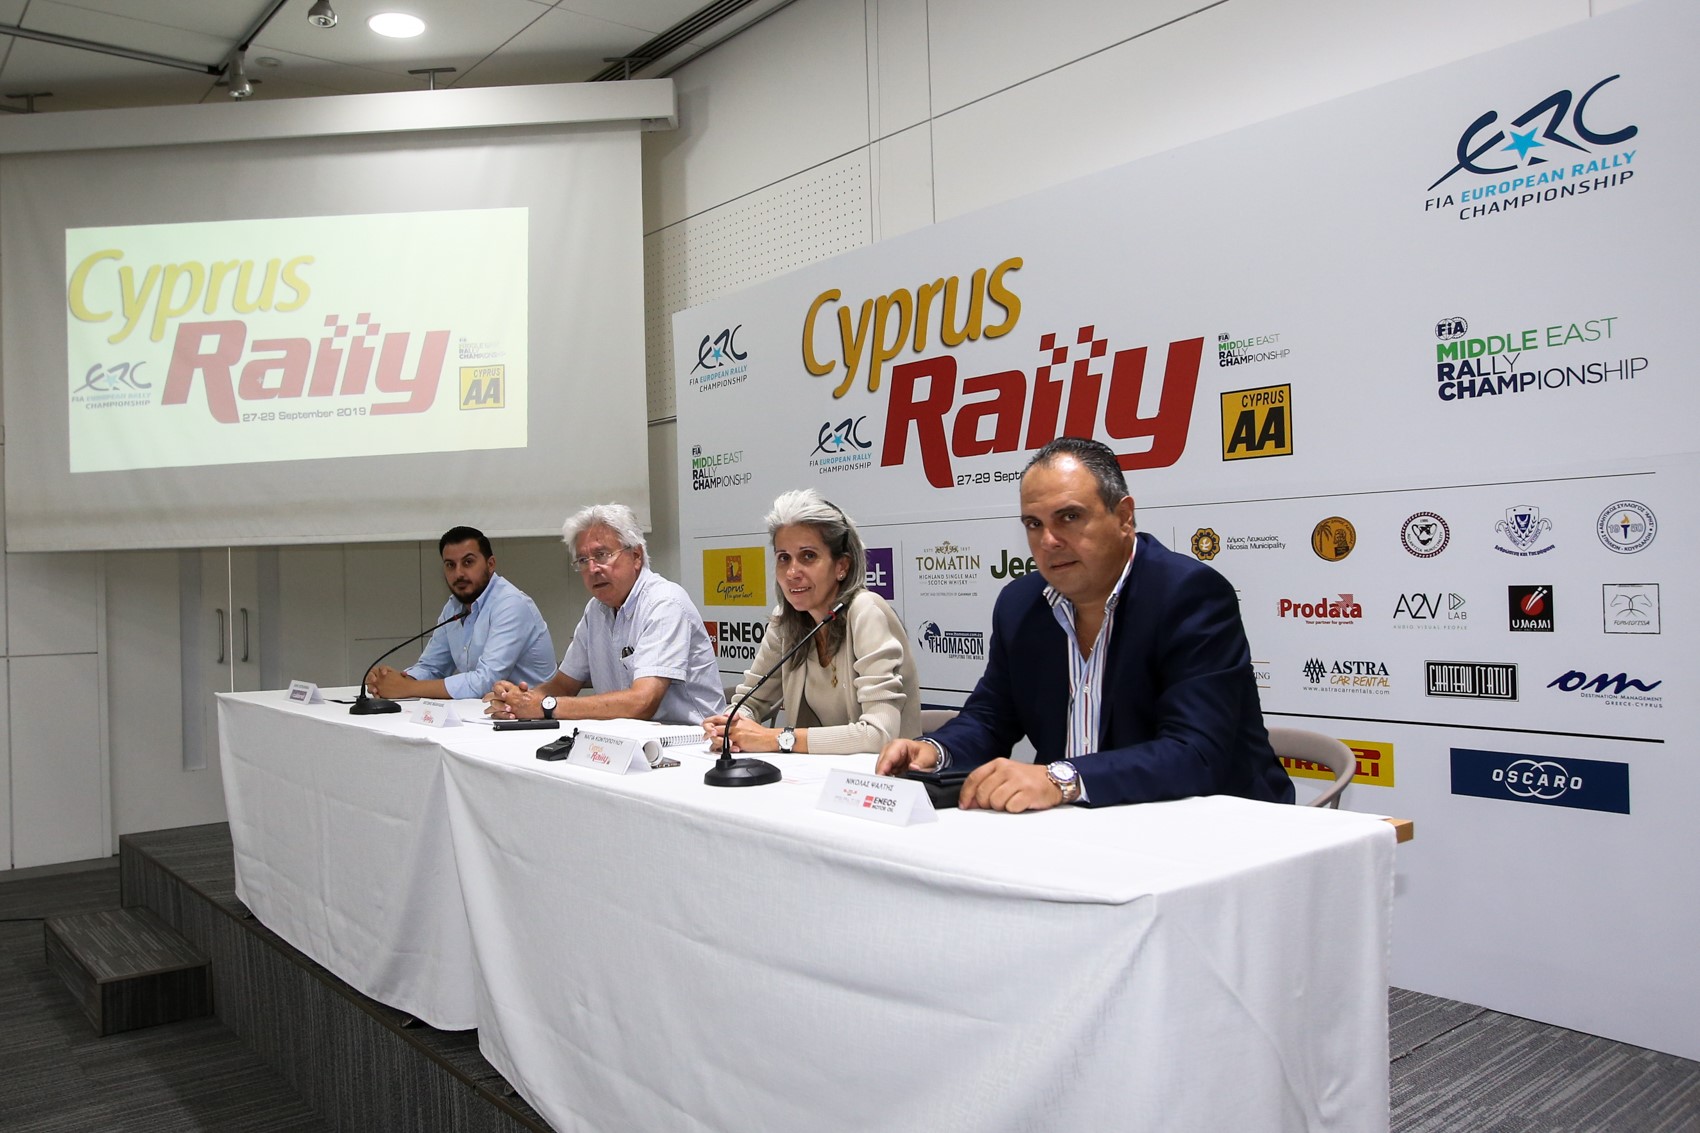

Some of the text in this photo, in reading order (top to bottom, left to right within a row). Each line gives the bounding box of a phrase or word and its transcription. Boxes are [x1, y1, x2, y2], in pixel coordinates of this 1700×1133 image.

[1425, 150, 1637, 211] FIA EUROPEAN RALLY
[1459, 170, 1634, 220] CHAMPIONSHIP
[68, 249, 315, 344] Cyprus
[803, 257, 1023, 398] Cyprus
[1218, 333, 1280, 351] MIDDLE EAST
[1436, 317, 1618, 362] MIDDLE EAST
[1219, 347, 1248, 359] RALLY
[1219, 349, 1290, 367] CHAMPIONSHIP
[161, 312, 451, 424] Rally
[473, 368, 501, 378] CYPRUS
[689, 364, 748, 386] FIA EUROPEAN RALLY
[1437, 352, 1520, 382] RALLY
[699, 375, 748, 392] CHAMPIONSHIP
[1438, 357, 1648, 401] CHAMPIONSHIP
[463, 378, 500, 405] AA
[1241, 390, 1284, 408] CYPRUS
[86, 400, 151, 410] CHAMPIONSHIP
[880, 325, 1204, 488] Rally
[242, 407, 366, 422] 27-29 September 2019
[1227, 406, 1285, 453] AA
[692, 450, 744, 469] MIDDLE EAST
[819, 462, 872, 475] CHAMPIONSHIP
[820, 455, 851, 466] EUROPEAN
[852, 453, 872, 462] RALLY
[692, 467, 717, 480] RALLY
[693, 472, 752, 490] CHAMPIONSHIP
[957, 472, 991, 485] 27-29
[1250, 542, 1286, 550] Municipality
[916, 555, 980, 571] TOMATIN
[991, 549, 1038, 579] Jee
[717, 580, 744, 594] Cyprus
[1280, 598, 1362, 618] Prodata
[1393, 593, 1467, 620] A2V LAB
[1512, 619, 1550, 628] UMAMI
[720, 645, 756, 659] MOTOR
[929, 636, 984, 655] THOMASON
[1330, 660, 1389, 676] ASTRA
[1330, 675, 1390, 687] CAR RENTAL
[1429, 665, 1513, 698] CHATEAU STATUS
[1302, 686, 1390, 695] www.astracarrentals.com
[1605, 700, 1663, 708] GREECE-CYPRUS
[1492, 769, 1582, 790] OSCARO
[873, 796, 897, 807] ENEOS
